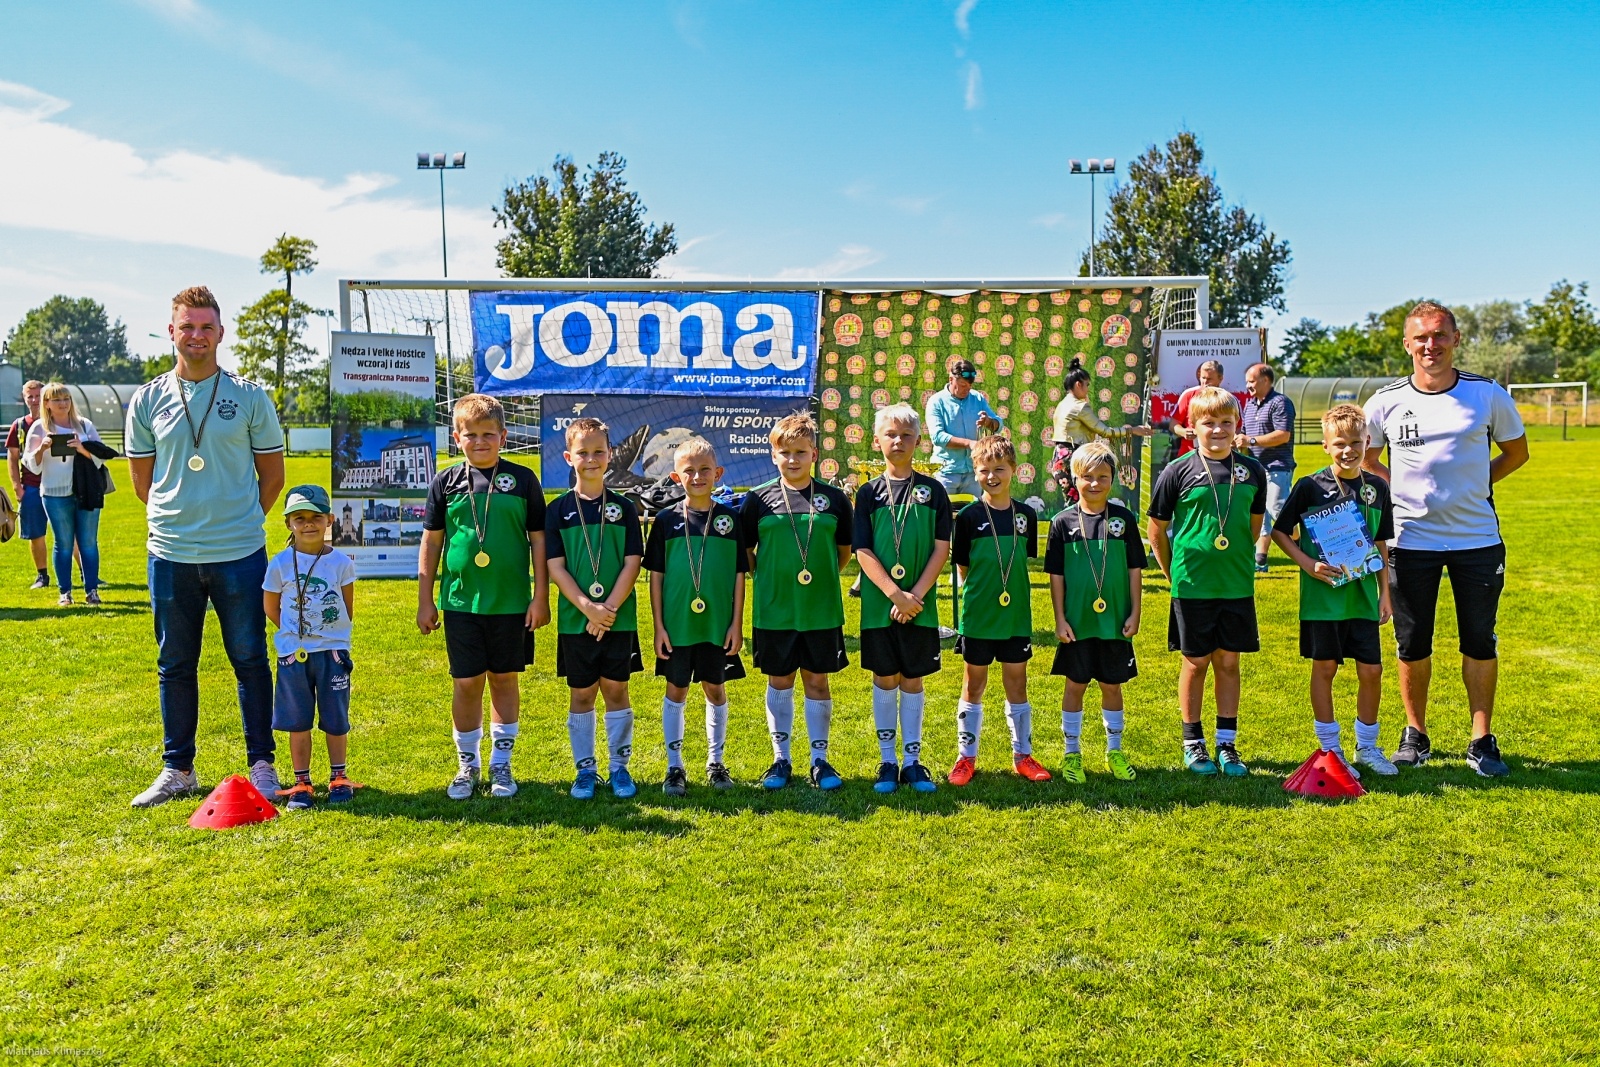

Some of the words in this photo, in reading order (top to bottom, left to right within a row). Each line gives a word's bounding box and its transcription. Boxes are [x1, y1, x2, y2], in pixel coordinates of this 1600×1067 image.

[1166, 339, 1189, 347] GMINNY
[1191, 337, 1234, 347] MŁODZIEŻOWY
[341, 346, 366, 357] Nędza
[372, 347, 395, 357] Velké
[1177, 349, 1210, 357] SPORTOWY
[1220, 348, 1240, 357] NĘDZA
[357, 359, 388, 370] wczoraj
[394, 359, 411, 369] dziś
[342, 372, 395, 382] Transgraniczna
[395, 374, 430, 383] Panorama
[673, 372, 806, 388] www.joma-sport.com
[704, 405, 725, 414] Sklep
[726, 407, 760, 415] sportowy
[702, 415, 730, 428] MW
[1398, 424, 1419, 440] JH
[729, 433, 770, 444] Racibó
[740, 447, 770, 455] Chopina
[1309, 500, 1350, 523] DYPLOM
